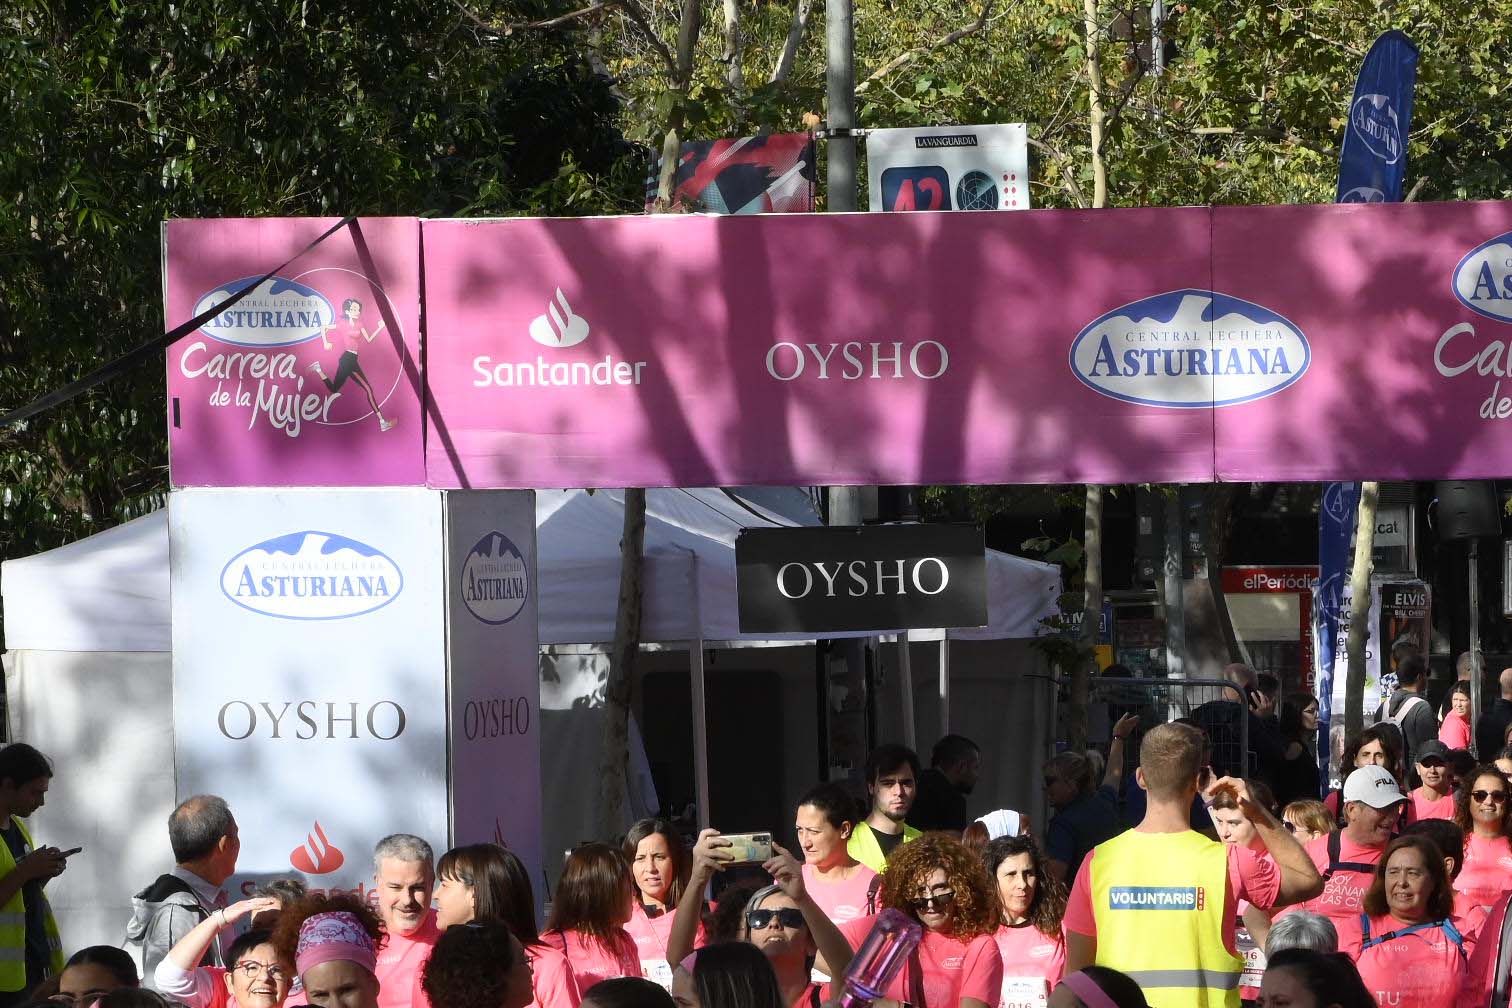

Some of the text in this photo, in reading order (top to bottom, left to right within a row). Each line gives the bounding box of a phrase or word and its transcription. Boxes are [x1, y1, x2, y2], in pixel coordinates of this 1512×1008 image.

[203, 302, 322, 329] ASTURIANA
[1125, 329, 1284, 342] CENTRAL LECHERA
[180, 341, 297, 380] Carrera
[473, 354, 646, 388] Santander
[765, 340, 950, 381] OYSHO
[1089, 334, 1293, 378] ASTURIANA
[209, 376, 342, 438] de la Mujer
[234, 564, 390, 599] ASTURIANA
[466, 569, 527, 603] ASTURIANA
[776, 557, 950, 599] OYSHO
[1395, 593, 1425, 606] ELVIS
[217, 699, 407, 741] OYSHO
[463, 696, 530, 742] OYSHO
[1375, 778, 1395, 788] FILA
[1111, 889, 1195, 908] VOLUNTARIS
[1376, 990, 1400, 1005] TU
